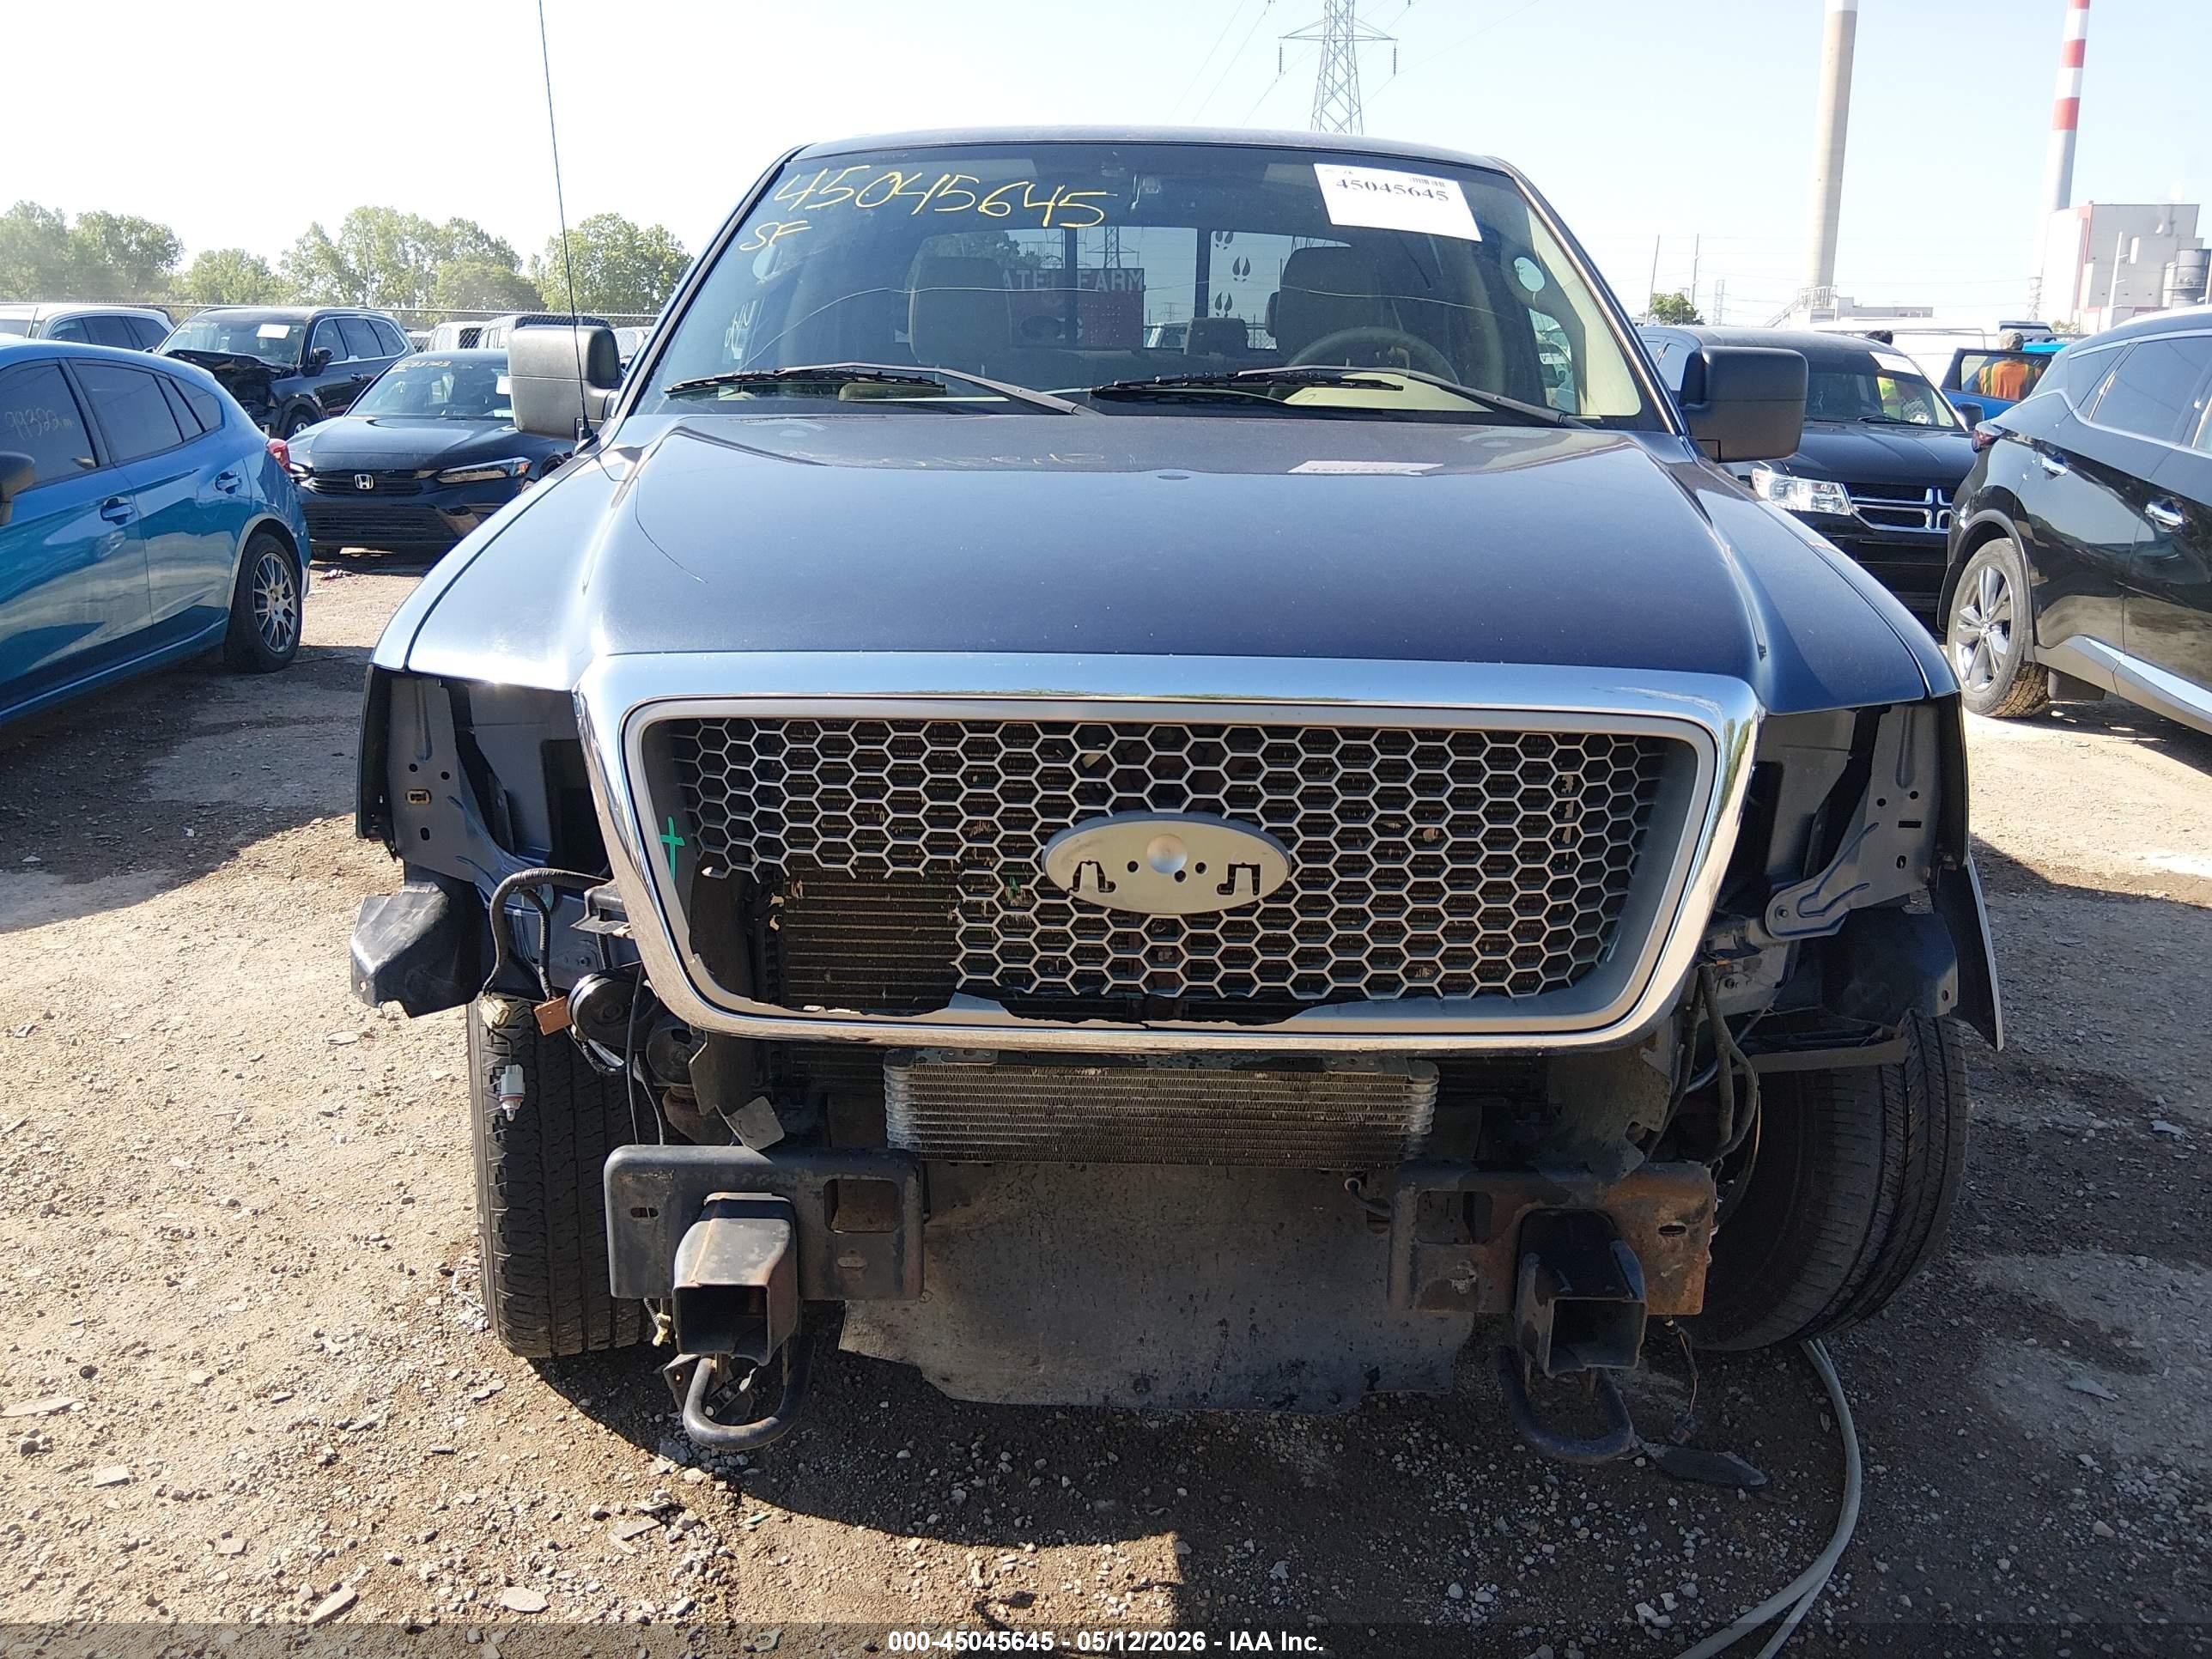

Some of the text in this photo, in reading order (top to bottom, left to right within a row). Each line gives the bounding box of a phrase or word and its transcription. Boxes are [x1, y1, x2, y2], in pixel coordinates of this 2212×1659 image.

[775, 165, 1119, 228] 45045645
[1336, 179, 1449, 202] 45045645
[738, 220, 814, 252] SF
